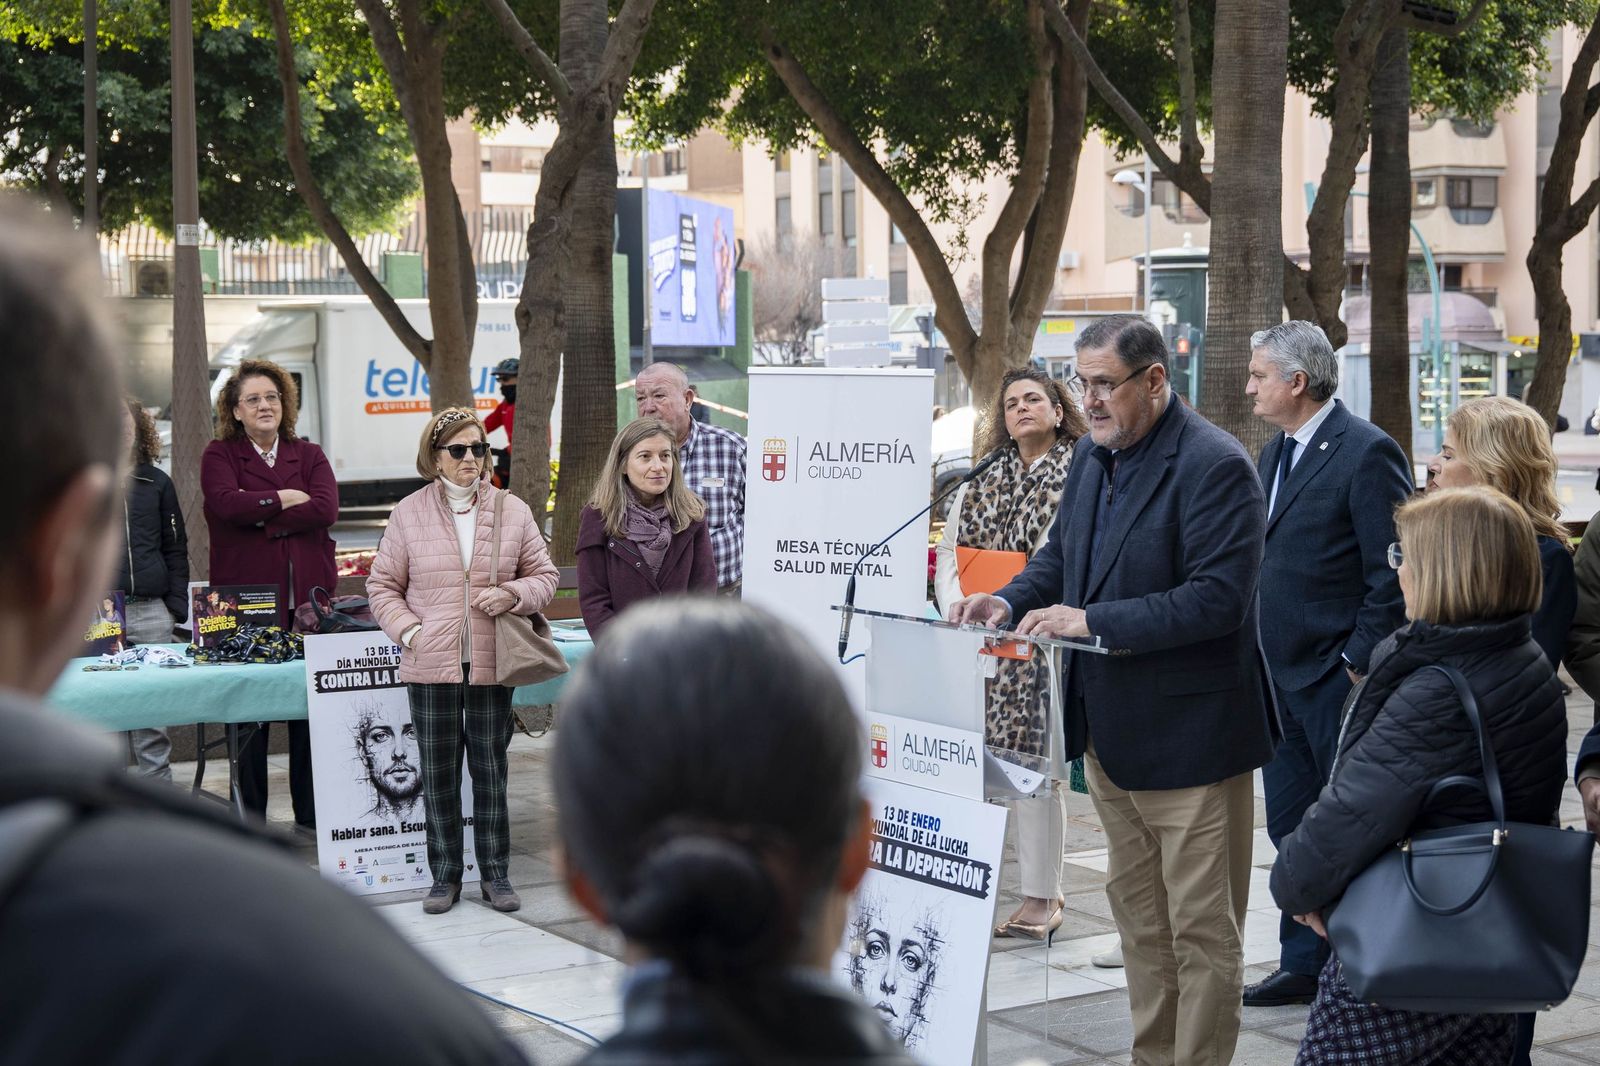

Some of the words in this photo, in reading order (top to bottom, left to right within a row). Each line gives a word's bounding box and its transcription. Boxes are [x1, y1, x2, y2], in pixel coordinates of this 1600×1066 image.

[809, 438, 915, 464] ALMERÍA
[808, 465, 862, 480] CIUDAD
[776, 540, 819, 555] MESA
[824, 539, 892, 558] TÉCNICA
[774, 560, 825, 574] SALUD
[830, 562, 893, 577] MENTAL
[199, 621, 237, 634] cuentos
[365, 647, 376, 657] 13
[378, 646, 389, 656] DE
[337, 657, 352, 669] DÍA
[354, 656, 393, 667] MUNDIAL
[320, 672, 371, 689] CONTRA
[374, 670, 392, 685] LA
[902, 733, 977, 768] ALMERÍA
[902, 756, 940, 777] CIUDAD
[884, 805, 895, 821] 13
[897, 809, 909, 824] DE
[911, 811, 941, 832] ENERO
[331, 827, 367, 841] Hablar
[370, 825, 398, 837] sana.
[912, 829, 924, 845] DE
[925, 832, 937, 848] LA
[939, 835, 969, 857] LUCHA
[884, 844, 902, 870] LA
[906, 850, 984, 891] DEPRESIÓN
